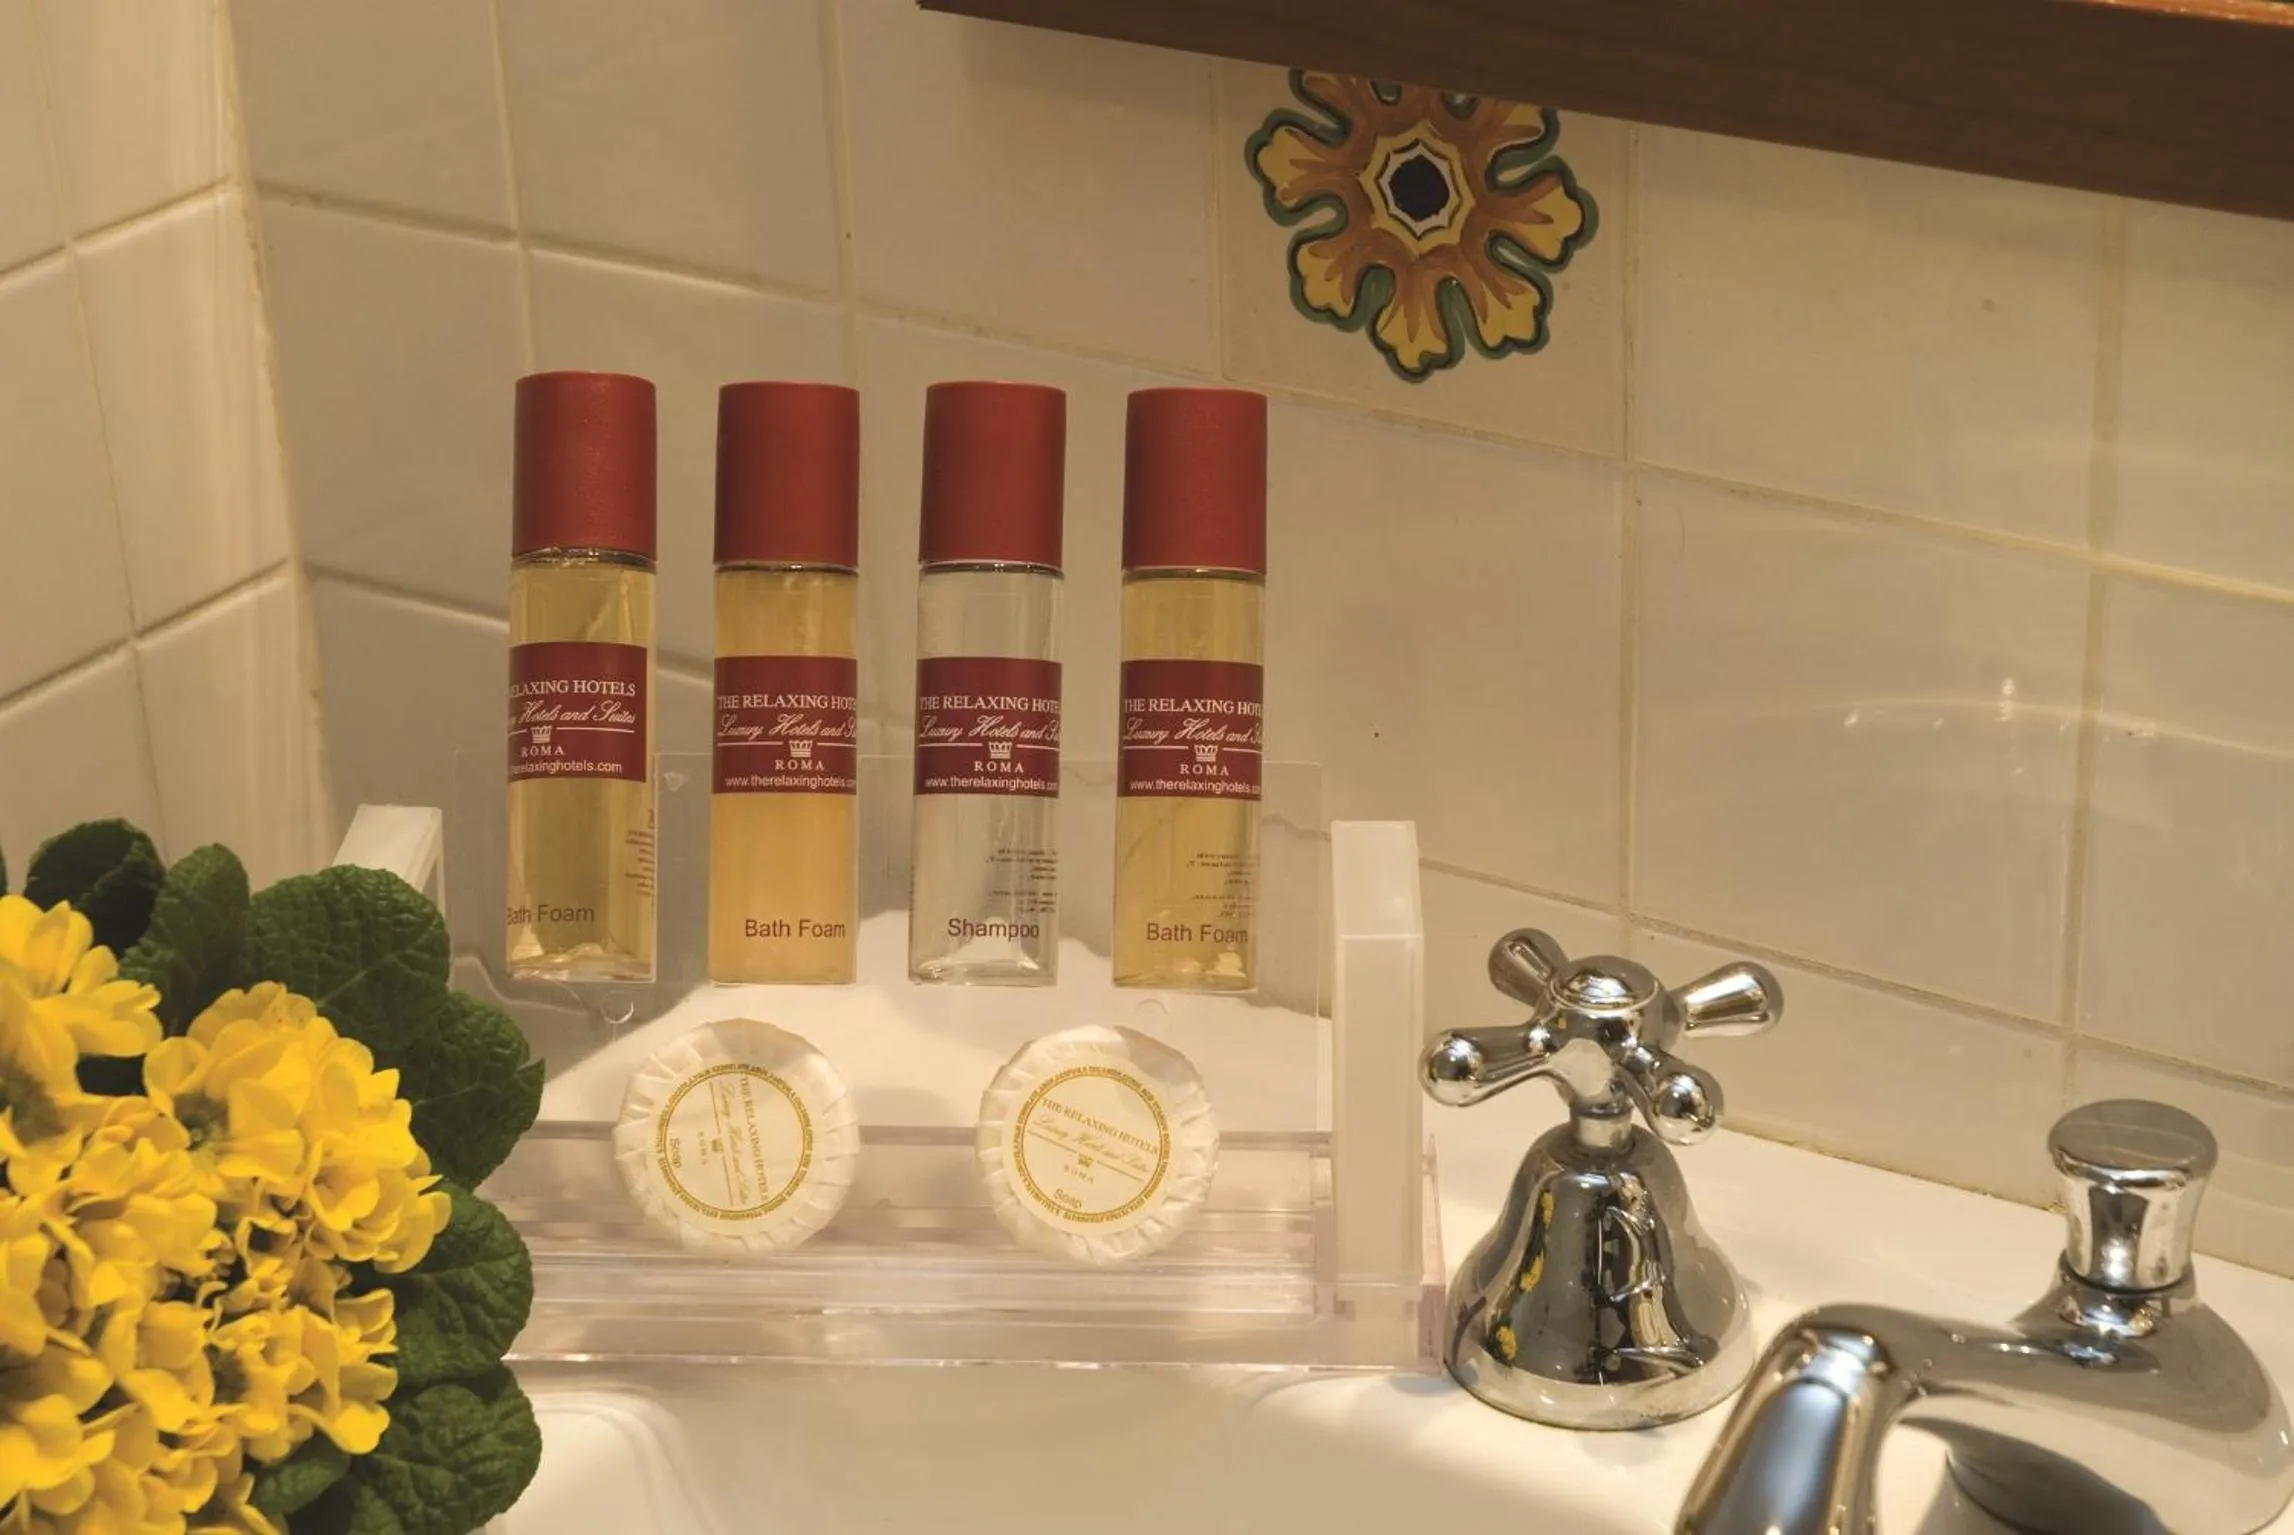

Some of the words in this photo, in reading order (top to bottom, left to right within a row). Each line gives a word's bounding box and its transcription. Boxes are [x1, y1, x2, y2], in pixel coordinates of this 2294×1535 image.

[573, 679, 637, 697] HOTELS
[560, 705, 596, 722] and
[593, 699, 637, 725] Suites
[717, 694, 740, 710] THE
[742, 693, 829, 710] RELAXING
[919, 696, 941, 711] THE
[942, 695, 1030, 712] RELAXING
[1123, 698, 1146, 713] THE
[1148, 697, 1235, 715] RELAXING
[717, 713, 765, 741] Luxury
[768, 713, 823, 738] Hotels
[819, 721, 847, 738] and
[919, 715, 964, 743] Luxury
[967, 714, 1023, 739] Hotels
[1019, 724, 1048, 741] and
[1121, 717, 1171, 745] Luxury
[1174, 717, 1229, 742] Hotels
[1224, 728, 1252, 744] and
[521, 745, 565, 758] ROMA
[774, 759, 826, 772] ROMA
[973, 760, 1025, 774] ROMA
[1179, 764, 1230, 777] ROMA
[537, 903, 596, 923] Foam
[744, 918, 791, 938] Bath
[798, 918, 846, 939] Foam
[947, 917, 1040, 943] Shampoo
[1146, 922, 1192, 942] Bath
[1199, 923, 1249, 944] Foam
[744, 1100, 761, 1158] RELAXING
[1064, 1107, 1117, 1138] RELAXING
[670, 1137, 682, 1169] Soap
[1053, 1188, 1082, 1209] Soap
